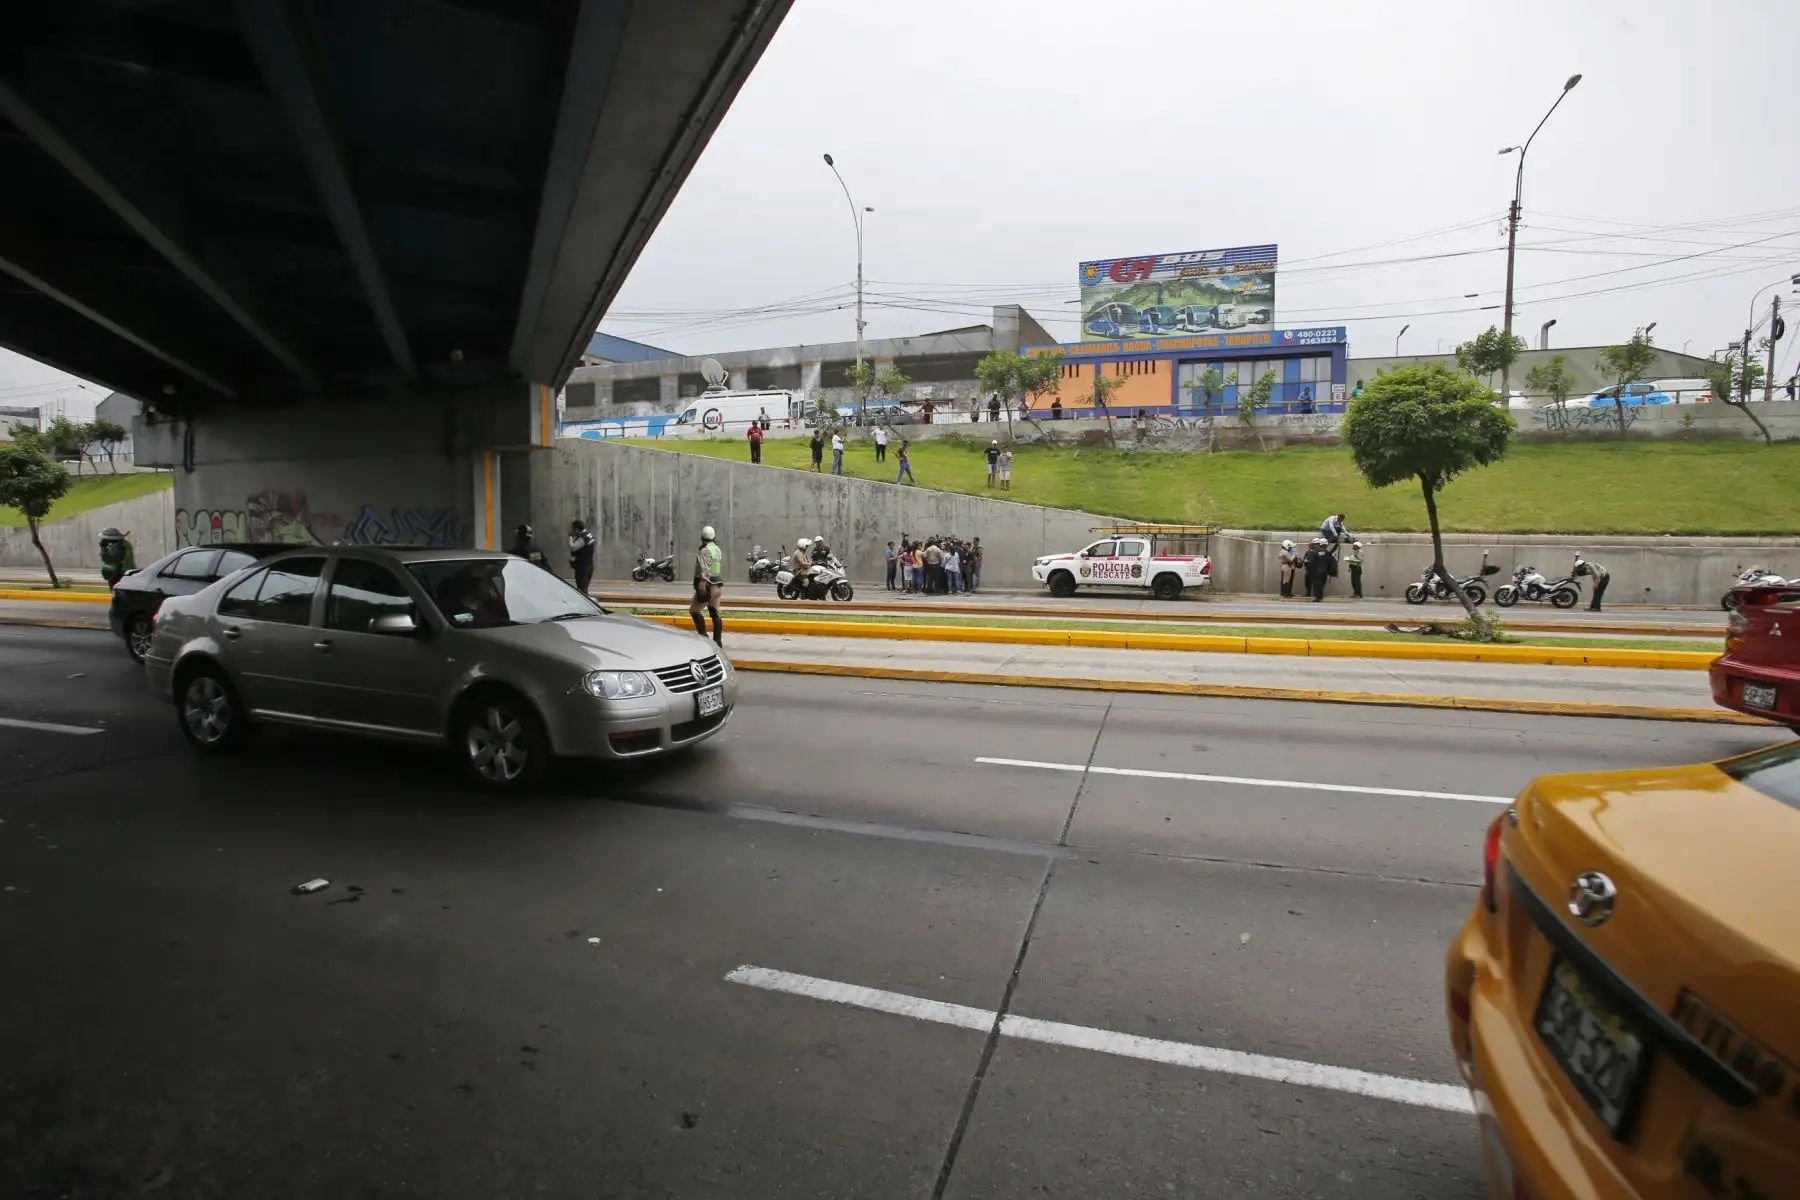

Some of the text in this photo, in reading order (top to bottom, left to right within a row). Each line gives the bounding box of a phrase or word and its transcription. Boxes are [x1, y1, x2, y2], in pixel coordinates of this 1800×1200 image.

[1297, 329, 1337, 338] 480-0223
[1092, 562, 1130, 572] POLICIA
[1092, 571, 1131, 579] RESCATE
